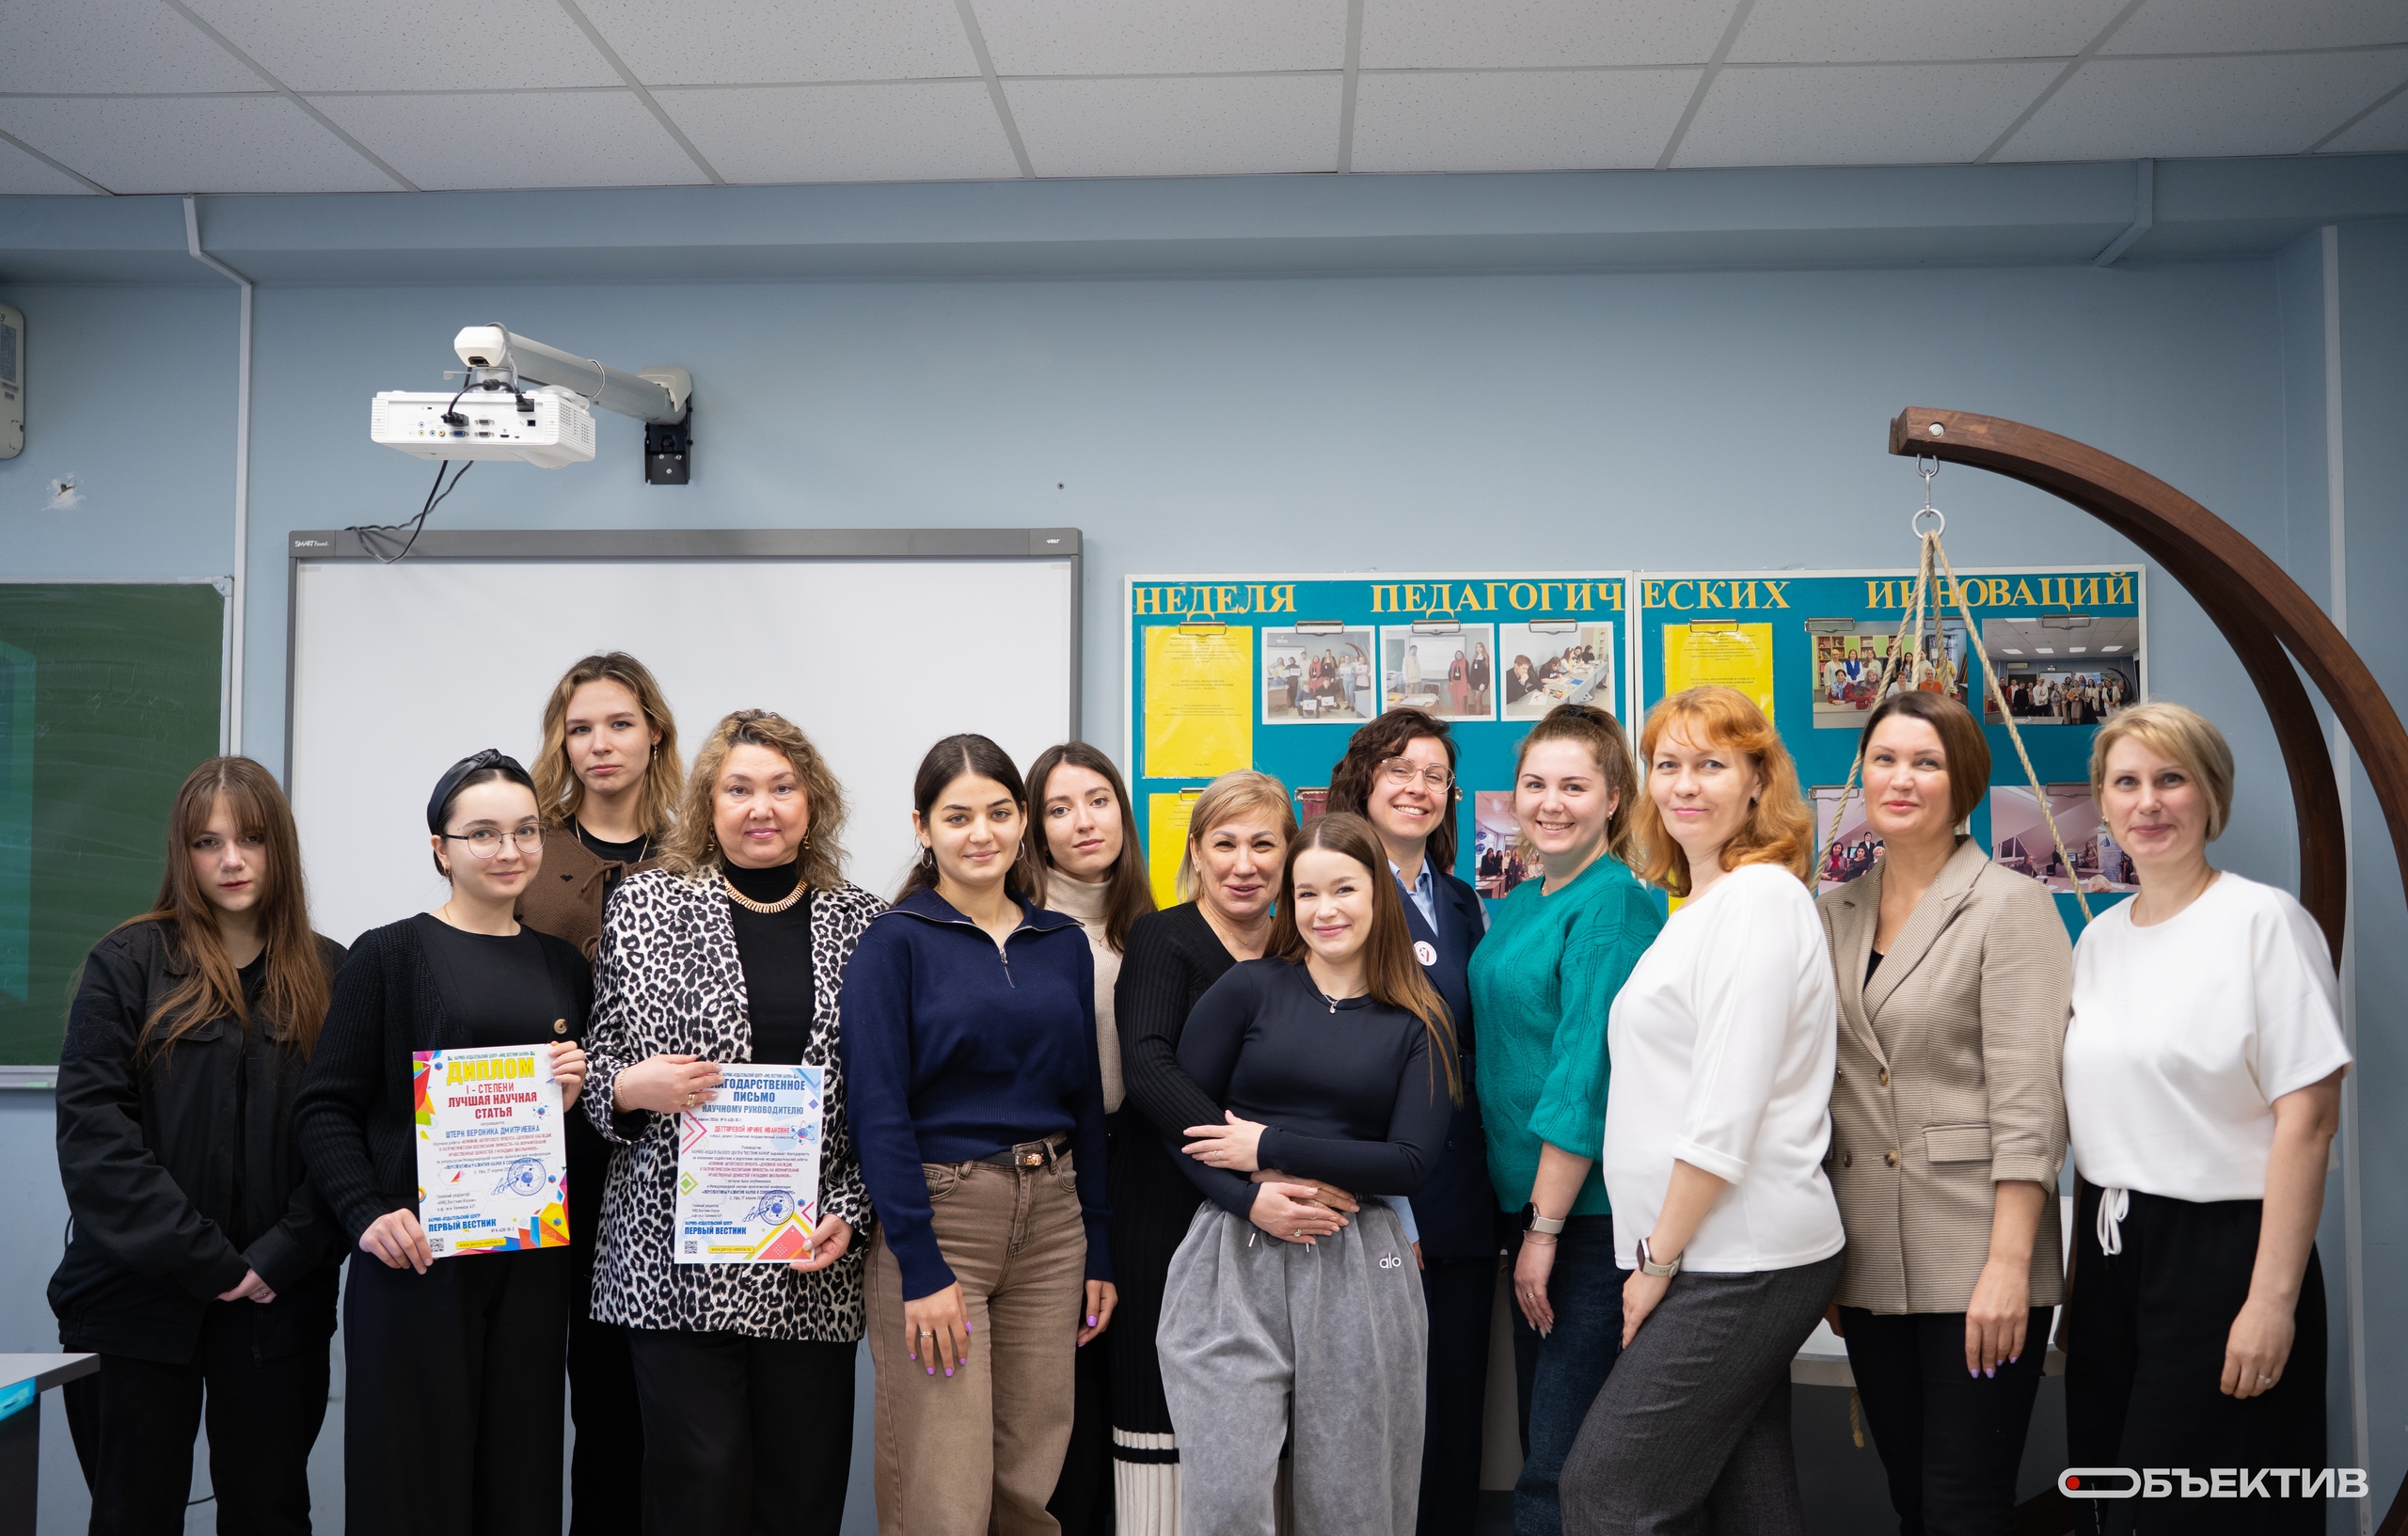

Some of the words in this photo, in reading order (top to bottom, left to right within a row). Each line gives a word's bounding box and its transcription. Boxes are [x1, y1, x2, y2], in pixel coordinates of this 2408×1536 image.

[1133, 584, 1297, 621] НЕДЕЛЯ
[1370, 581, 1625, 619] ПЕДАГОГИЧ
[1641, 580, 1791, 610] ЕСКИХ
[446, 1057, 534, 1085] ДИПЛОМ
[478, 1083, 515, 1093] СТЕПЕНИ
[706, 1079, 805, 1090] ГОДАРСТВЕННОЕ
[448, 1095, 490, 1107] ЛУЧШАЯ
[493, 1092, 537, 1104] НАУЧНАЯ
[733, 1091, 775, 1102] ПИСЬМО
[475, 1107, 513, 1118] СТАТЬЯ
[702, 1104, 742, 1113] НАУЧНОМУ
[744, 1105, 803, 1115] РУКОВОДИТЕЛЮ
[446, 1130, 465, 1138] ШТЕРН
[467, 1128, 499, 1137] ВЕРОНИКА
[500, 1125, 540, 1135] ДМИТРИЕВНА
[714, 1125, 745, 1133] ДЕГТЯРЕВОЙ
[428, 1221, 461, 1232] ПЕРВЫЙ
[463, 1218, 497, 1229] ВЕСТНИК
[684, 1226, 713, 1234] ПЕРВЫЙ
[715, 1227, 747, 1235] ВЕСТНИК
[1379, 1253, 1402, 1269] alo
